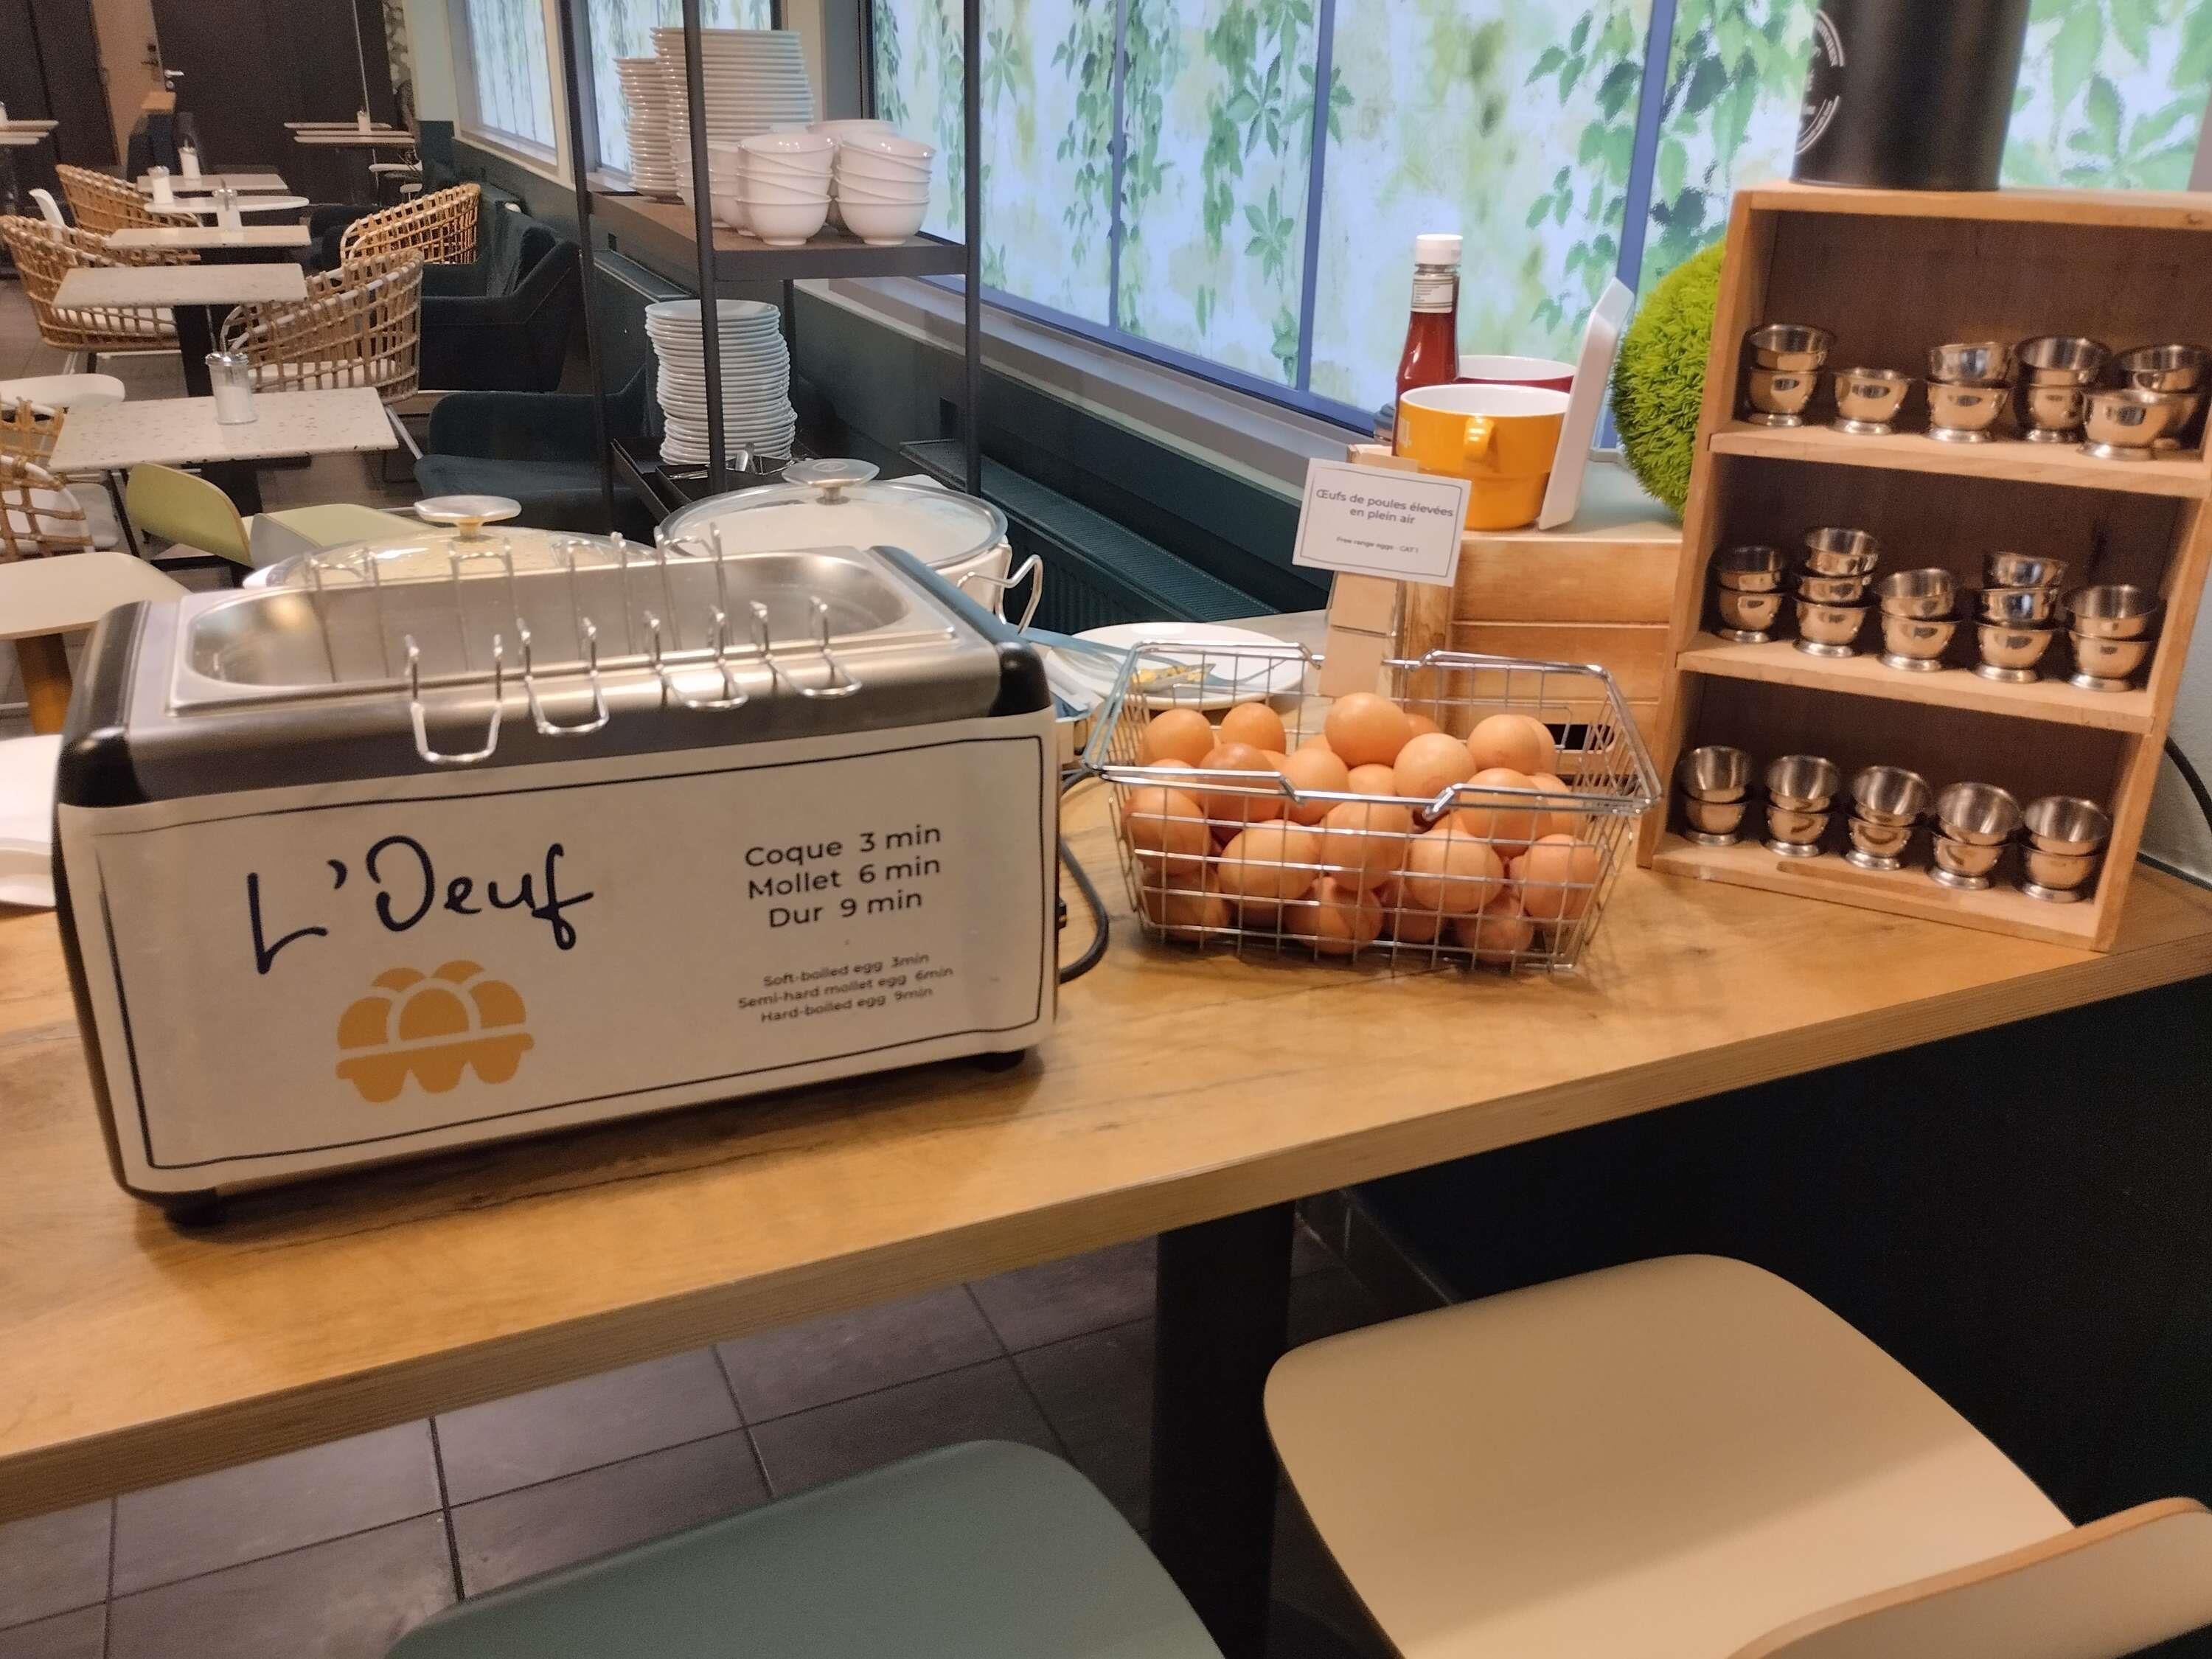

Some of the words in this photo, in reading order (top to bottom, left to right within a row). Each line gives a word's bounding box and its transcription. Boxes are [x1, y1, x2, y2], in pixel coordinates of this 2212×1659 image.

[1316, 489, 1346, 502] Œufs
[1349, 495, 1364, 504] de
[1367, 497, 1407, 510] poules
[1410, 500, 1453, 517] élevées
[1350, 509, 1364, 517] en
[1367, 509, 1397, 521] plein
[1399, 515, 1416, 524] air
[745, 841, 844, 866] Coque
[859, 831, 876, 852] 3
[886, 824, 941, 849] min
[748, 870, 842, 899] Mollet
[859, 864, 876, 883] 6
[886, 855, 941, 880] min
[247, 835, 594, 975] L'Oeuf
[769, 906, 824, 928] Dur
[841, 898, 857, 917] 9
[867, 889, 922, 914] min
[853, 960, 883, 974] egg
[891, 953, 929, 968] 3min
[738, 986, 820, 1009] Semi-hard
[824, 978, 873, 995] mollet
[877, 973, 907, 987] egg
[914, 966, 953, 981] 6min
[761, 998, 853, 1023] Hard-boiled
[857, 994, 886, 1007] egg
[893, 986, 933, 1001] 9min
